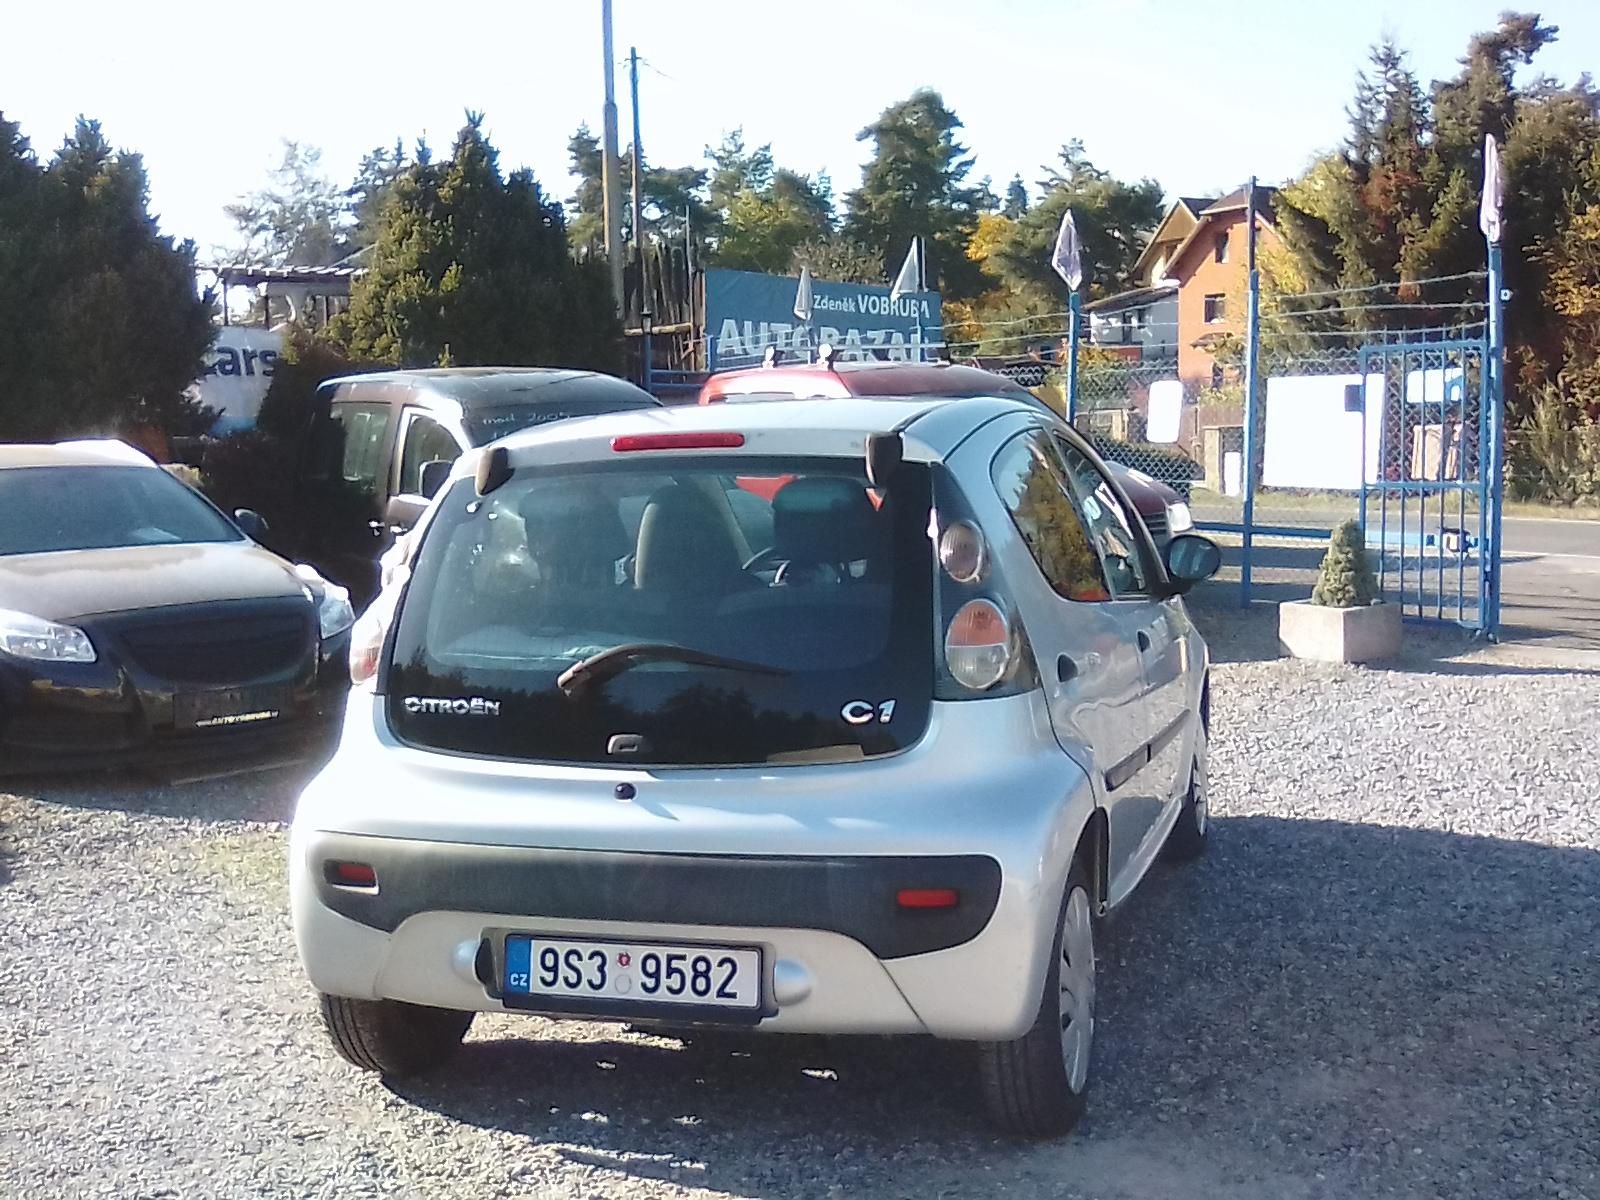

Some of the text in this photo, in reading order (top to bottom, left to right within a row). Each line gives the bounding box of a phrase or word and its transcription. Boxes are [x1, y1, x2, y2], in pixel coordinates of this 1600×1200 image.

[813, 294, 930, 319] Zdeněk VOBRUBA
[204, 346, 277, 377] ars
[404, 696, 501, 716] CITROËN
[841, 699, 896, 724] C1
[510, 947, 738, 999] CZ 9S3 9582
